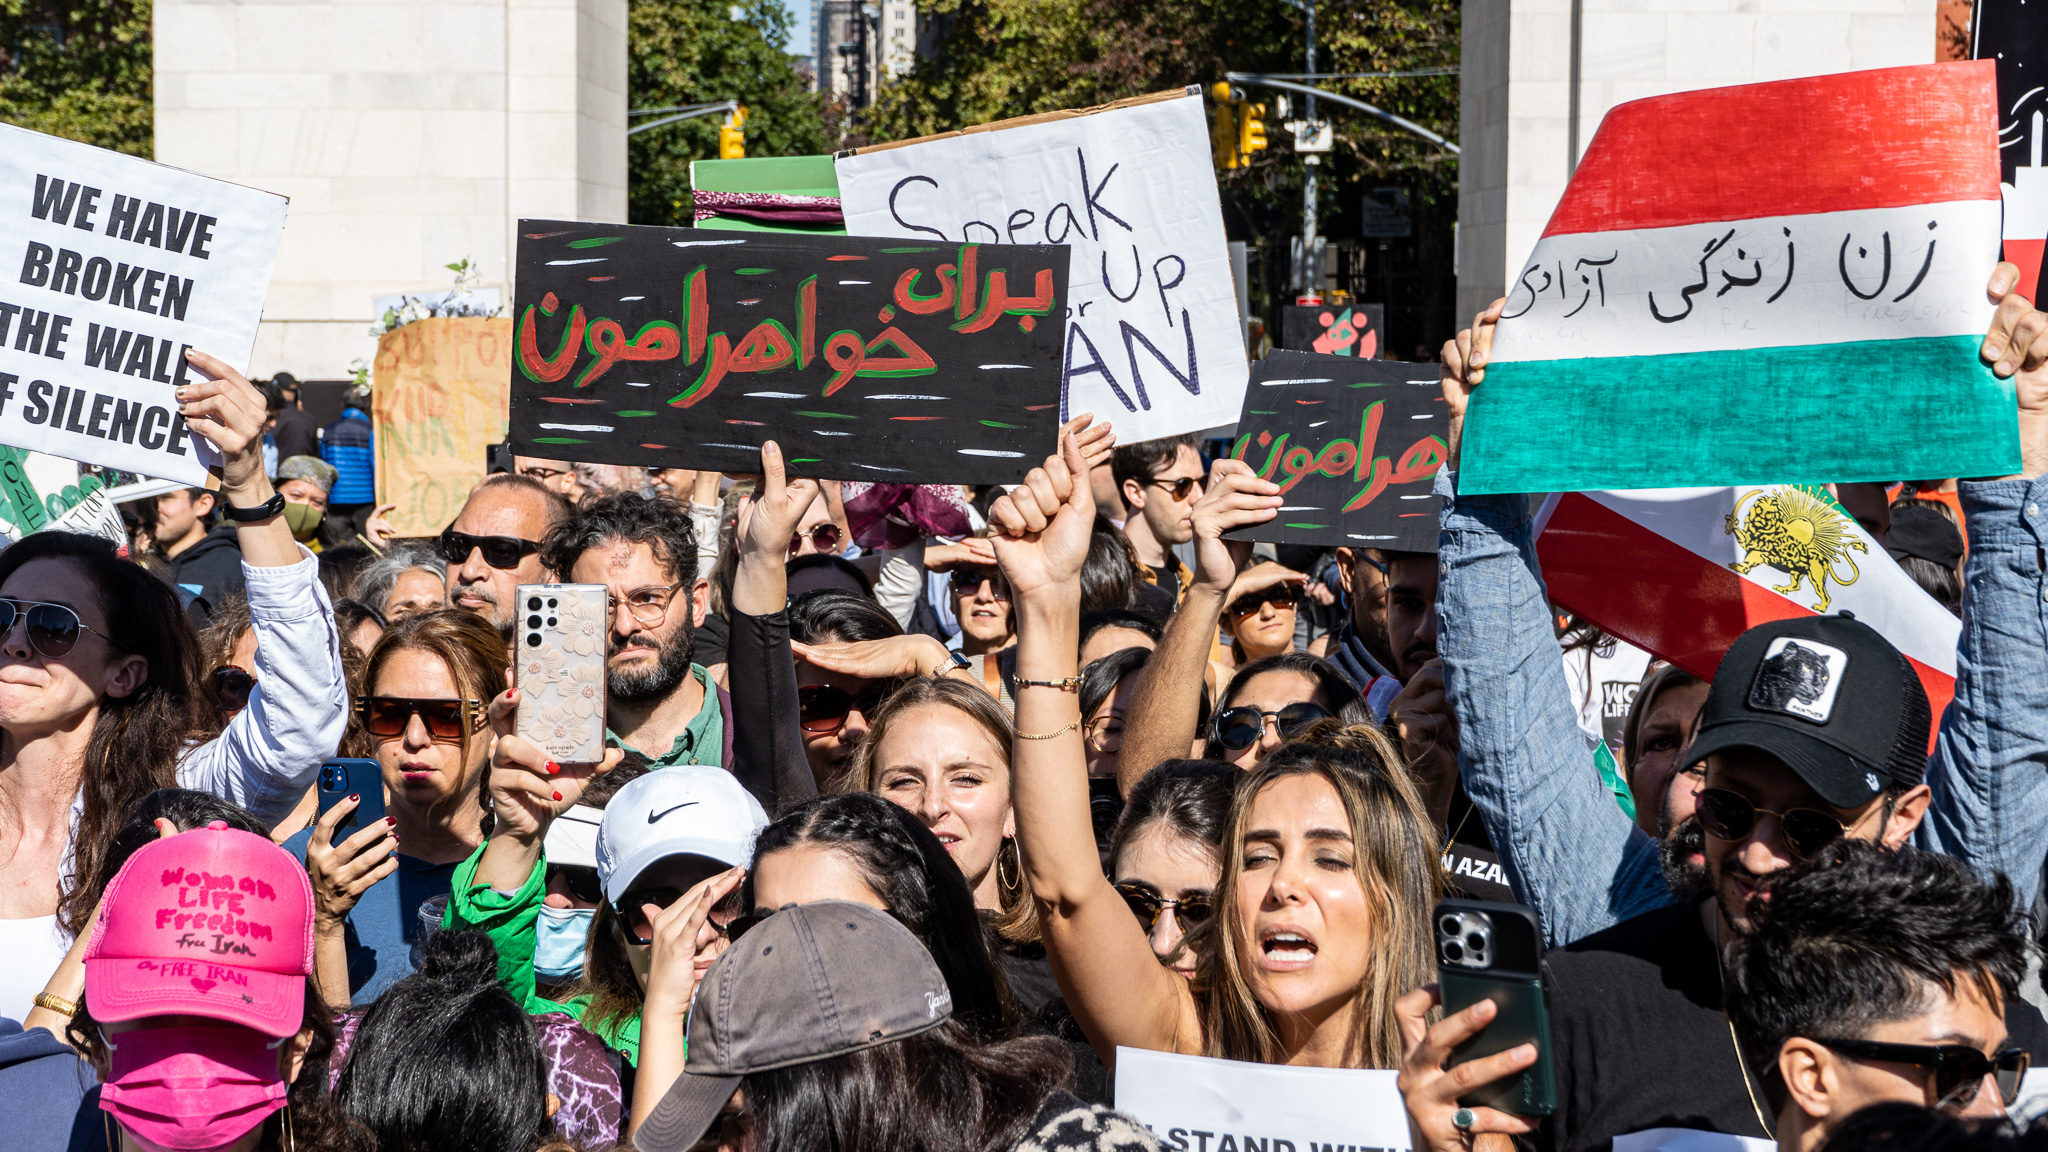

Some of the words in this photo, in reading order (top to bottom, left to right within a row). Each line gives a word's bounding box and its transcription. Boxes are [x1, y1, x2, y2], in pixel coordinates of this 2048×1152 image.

[31, 173, 102, 232] WE
[105, 193, 217, 260] HAVE
[19, 240, 194, 322] BROKEN
[893, 242, 1057, 335] برای
[1500, 249, 1618, 320] آزادی
[1648, 226, 1795, 324] زندگی
[1840, 220, 1938, 303] زن
[0, 301, 73, 360] THE
[84, 321, 193, 386] WALL
[1060, 307, 1201, 424] AN
[22, 379, 190, 457] SILENCE
[1231, 399, 1449, 515] هرامون
[160, 961, 199, 978] FREE
[205, 964, 248, 987] IRAN
